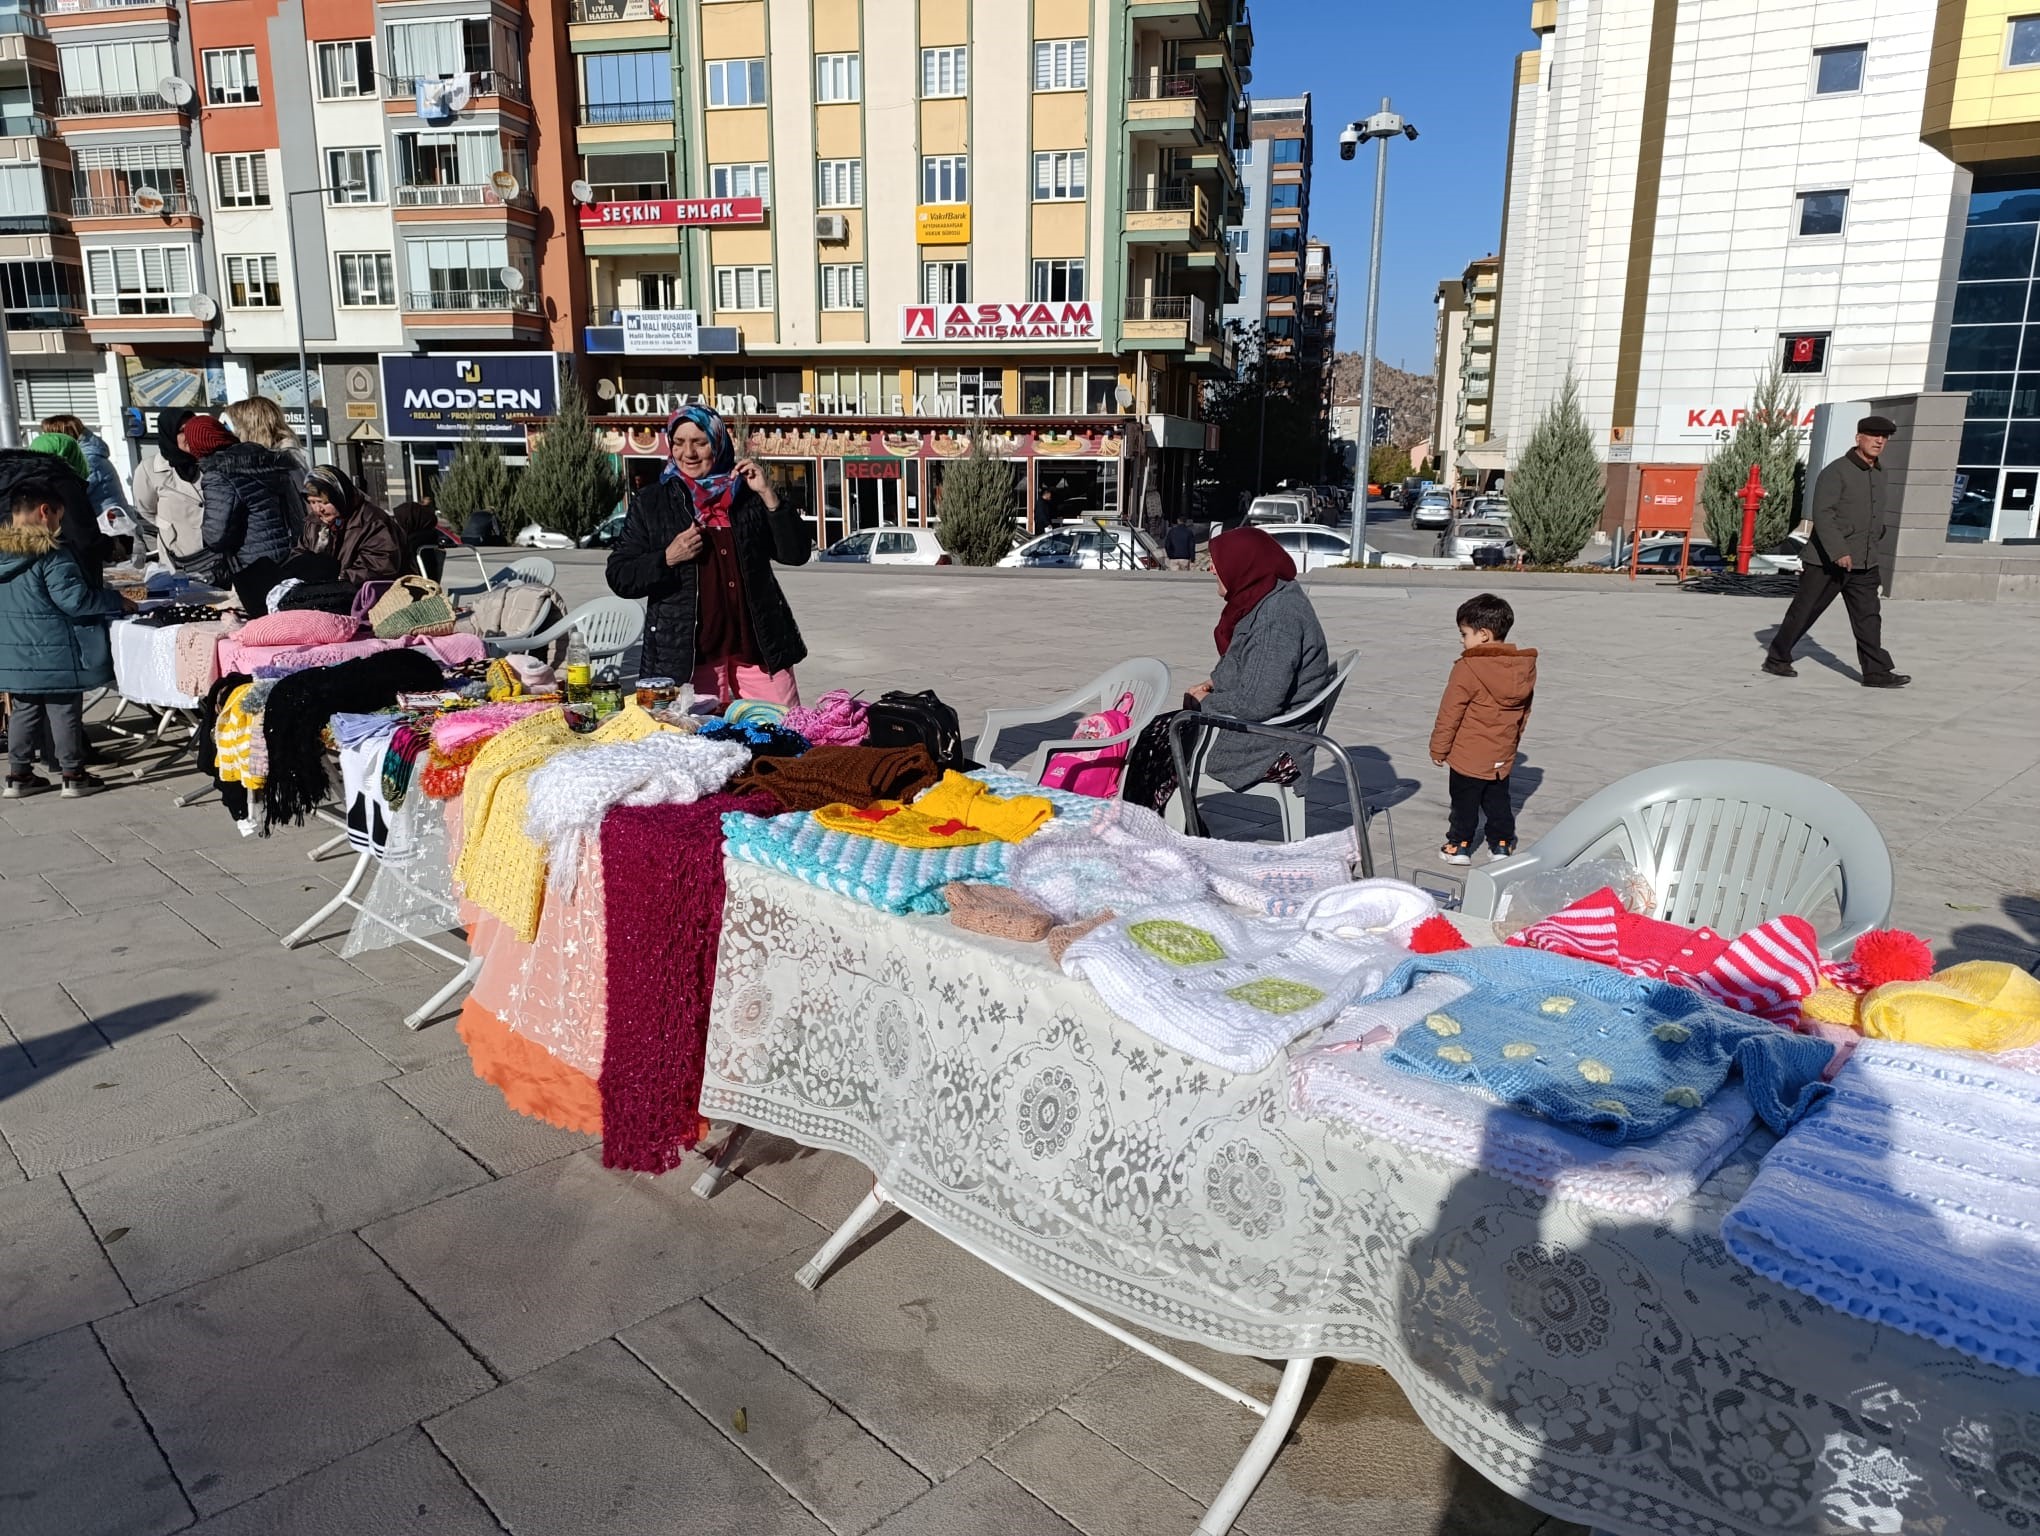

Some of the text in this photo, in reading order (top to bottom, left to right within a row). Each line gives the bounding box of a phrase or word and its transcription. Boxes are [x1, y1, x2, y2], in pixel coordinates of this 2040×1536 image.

[602, 202, 734, 224] SEÇKİN EMLAK
[944, 302, 1095, 325] ASYAM
[944, 323, 1095, 340] DANIŞMANLIK
[403, 388, 541, 409] MODERN
[891, 393, 1000, 418] EKMEK
[413, 411, 442, 420] REKLAM
